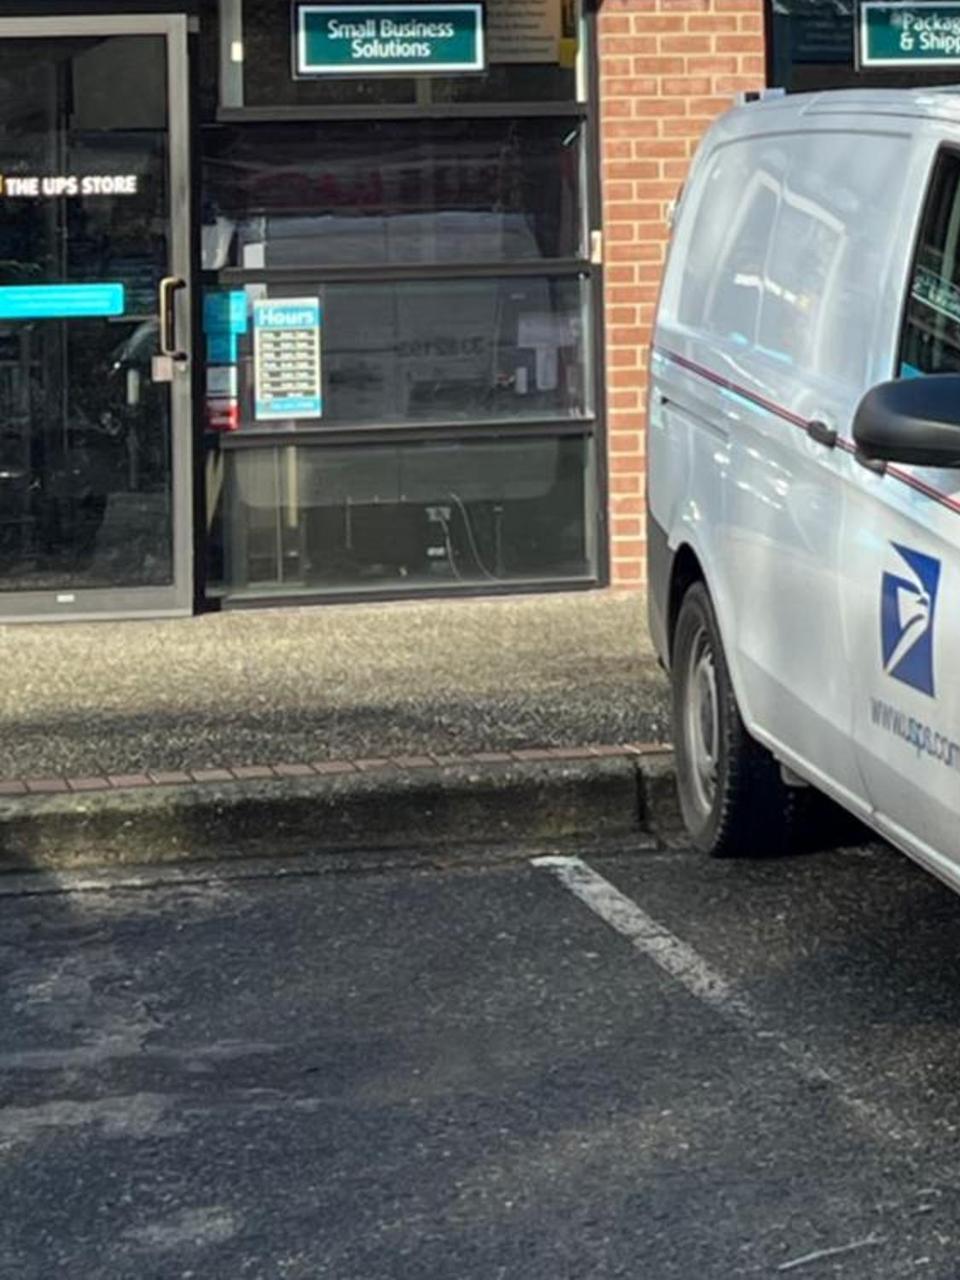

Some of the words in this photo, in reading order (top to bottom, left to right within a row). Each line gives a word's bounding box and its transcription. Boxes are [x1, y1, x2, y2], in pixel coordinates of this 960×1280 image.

[327, 19, 376, 39] Small
[380, 17, 454, 38] Business
[351, 39, 431, 59] Solutions
[900, 32, 914, 51] &
[6, 177, 39, 196] THE
[42, 176, 78, 196] UPS
[81, 175, 138, 195] STORE
[259, 308, 315, 326] Hours
